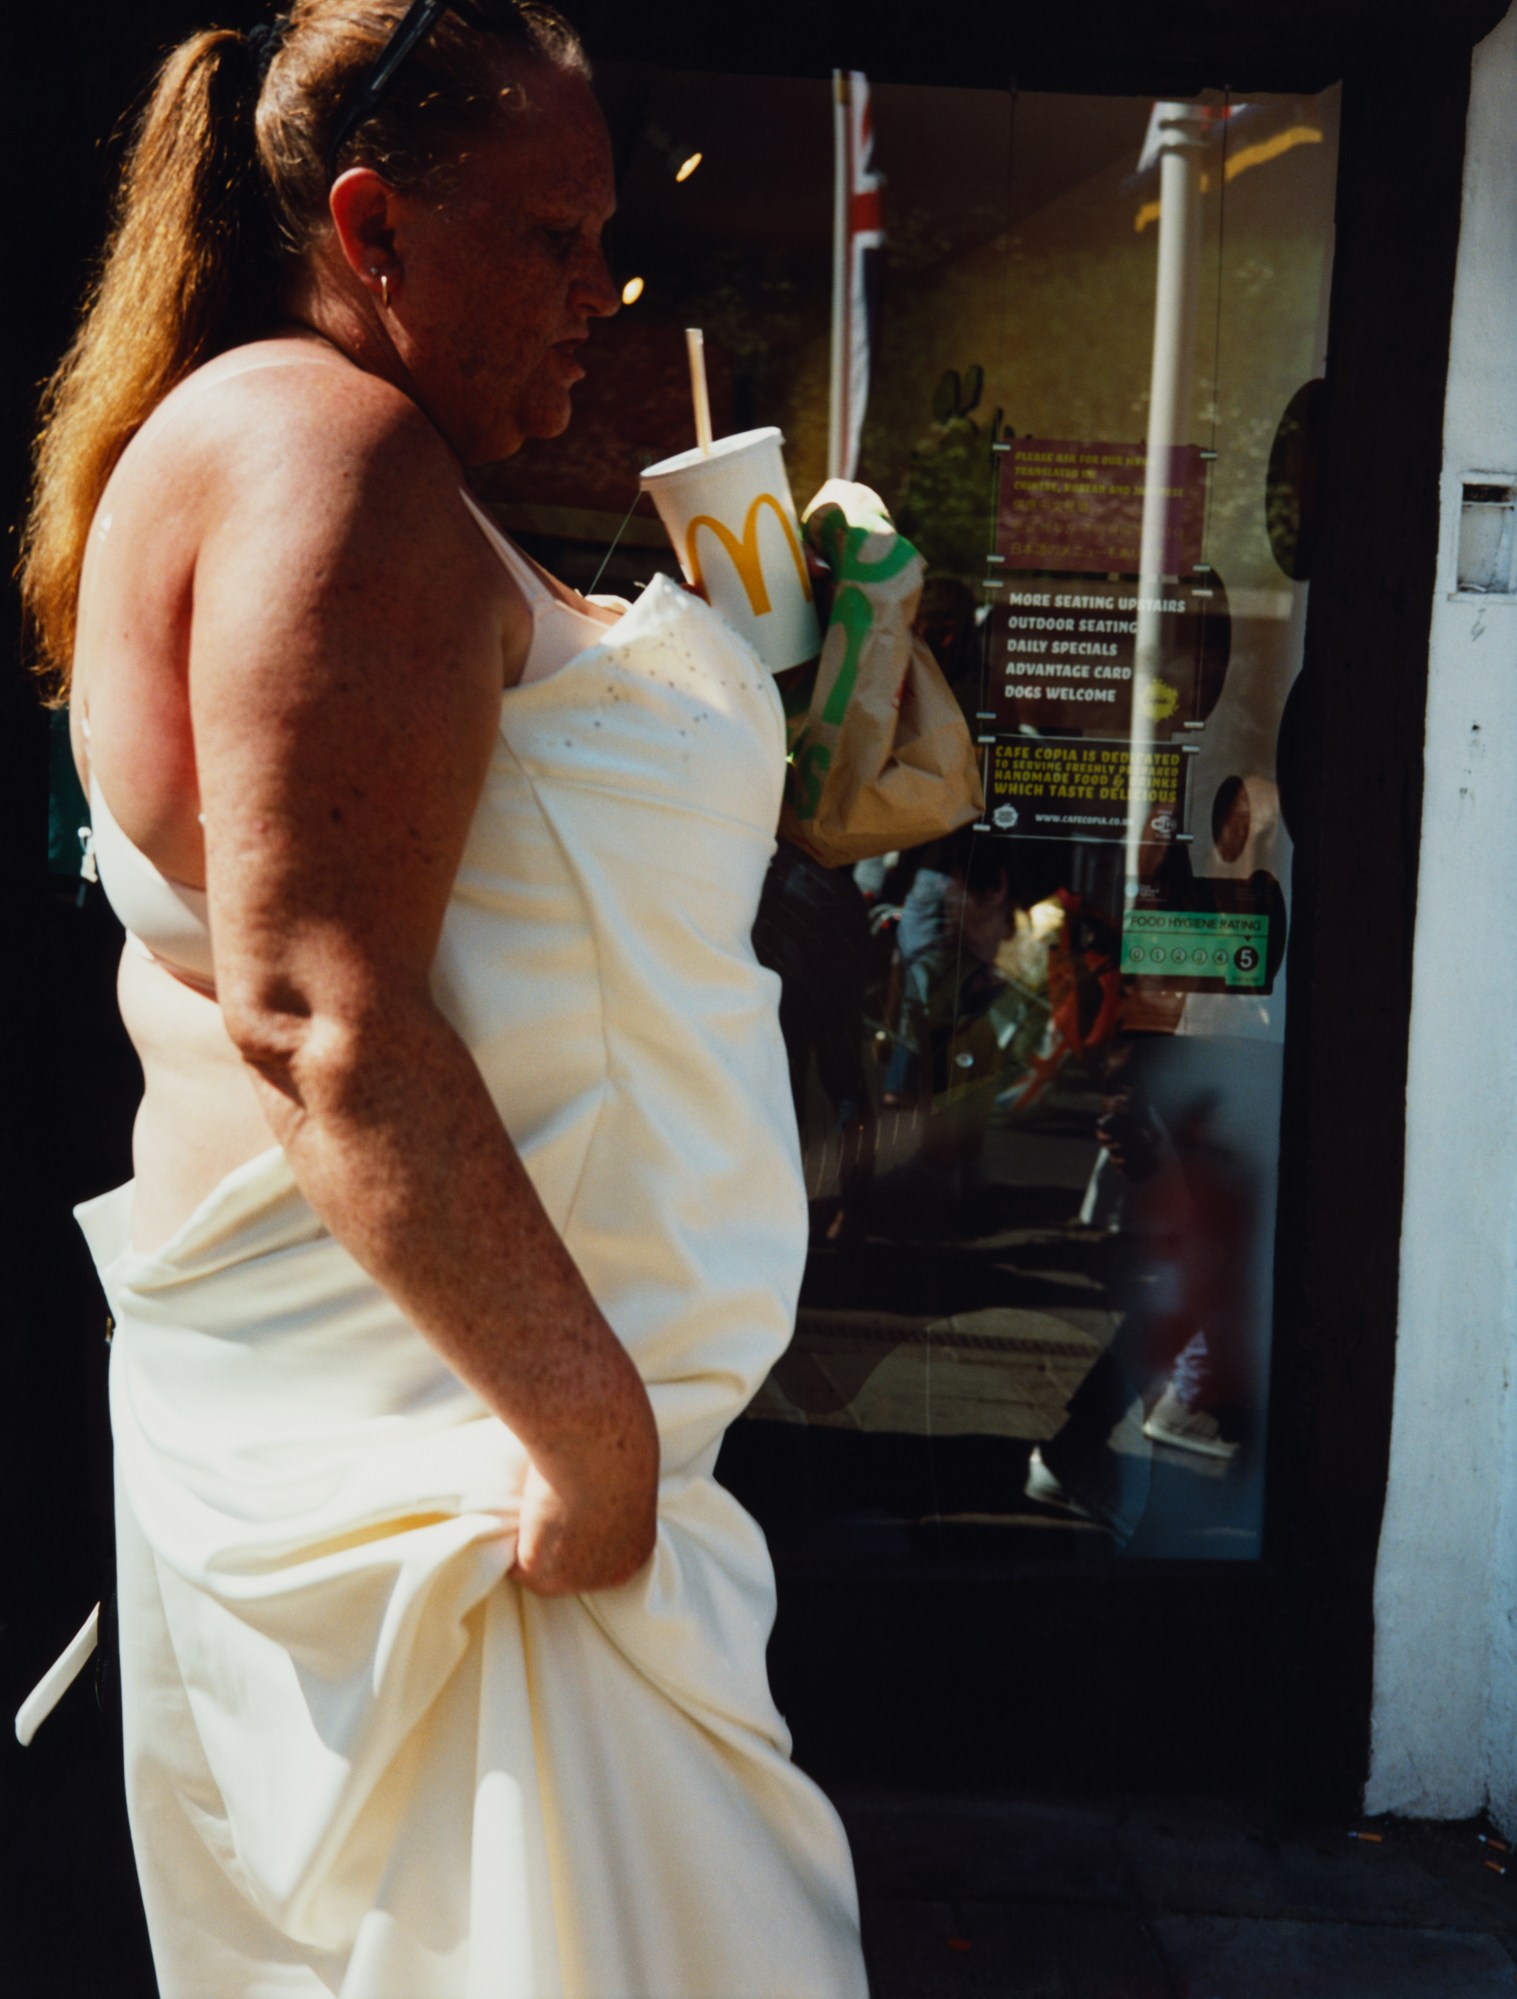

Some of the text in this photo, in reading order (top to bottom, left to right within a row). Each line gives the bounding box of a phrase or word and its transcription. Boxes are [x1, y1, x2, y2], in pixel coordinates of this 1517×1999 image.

[1015, 452, 1053, 463] PLEASE
[1010, 592, 1051, 607] MORE
[1055, 594, 1114, 610] SEATING
[1008, 616, 1138, 634] OUTDOOR SEATING
[1007, 639, 1118, 656] DAILY SPECIALS
[1005, 662, 1132, 680] ADVANTAGE CARD
[1005, 685, 1117, 703] DOGS WELCOME
[995, 746, 1030, 759] CAFE
[1034, 748, 1078, 761] COPIA
[1083, 750, 1096, 762] IS
[995, 759, 1008, 769] TO
[1012, 760, 1062, 772] SERVING
[1066, 762, 1114, 774] FRESHLY
[994, 770, 1069, 784] HANDMADE
[1074, 773, 1108, 785] FOOD
[1112, 773, 1125, 791] &
[994, 782, 1043, 796] WHICH
[1050, 784, 1094, 799] TASTE
[1131, 916, 1262, 931] FOOD HYGIENE RATING
[1240, 950, 1253, 968] 5
